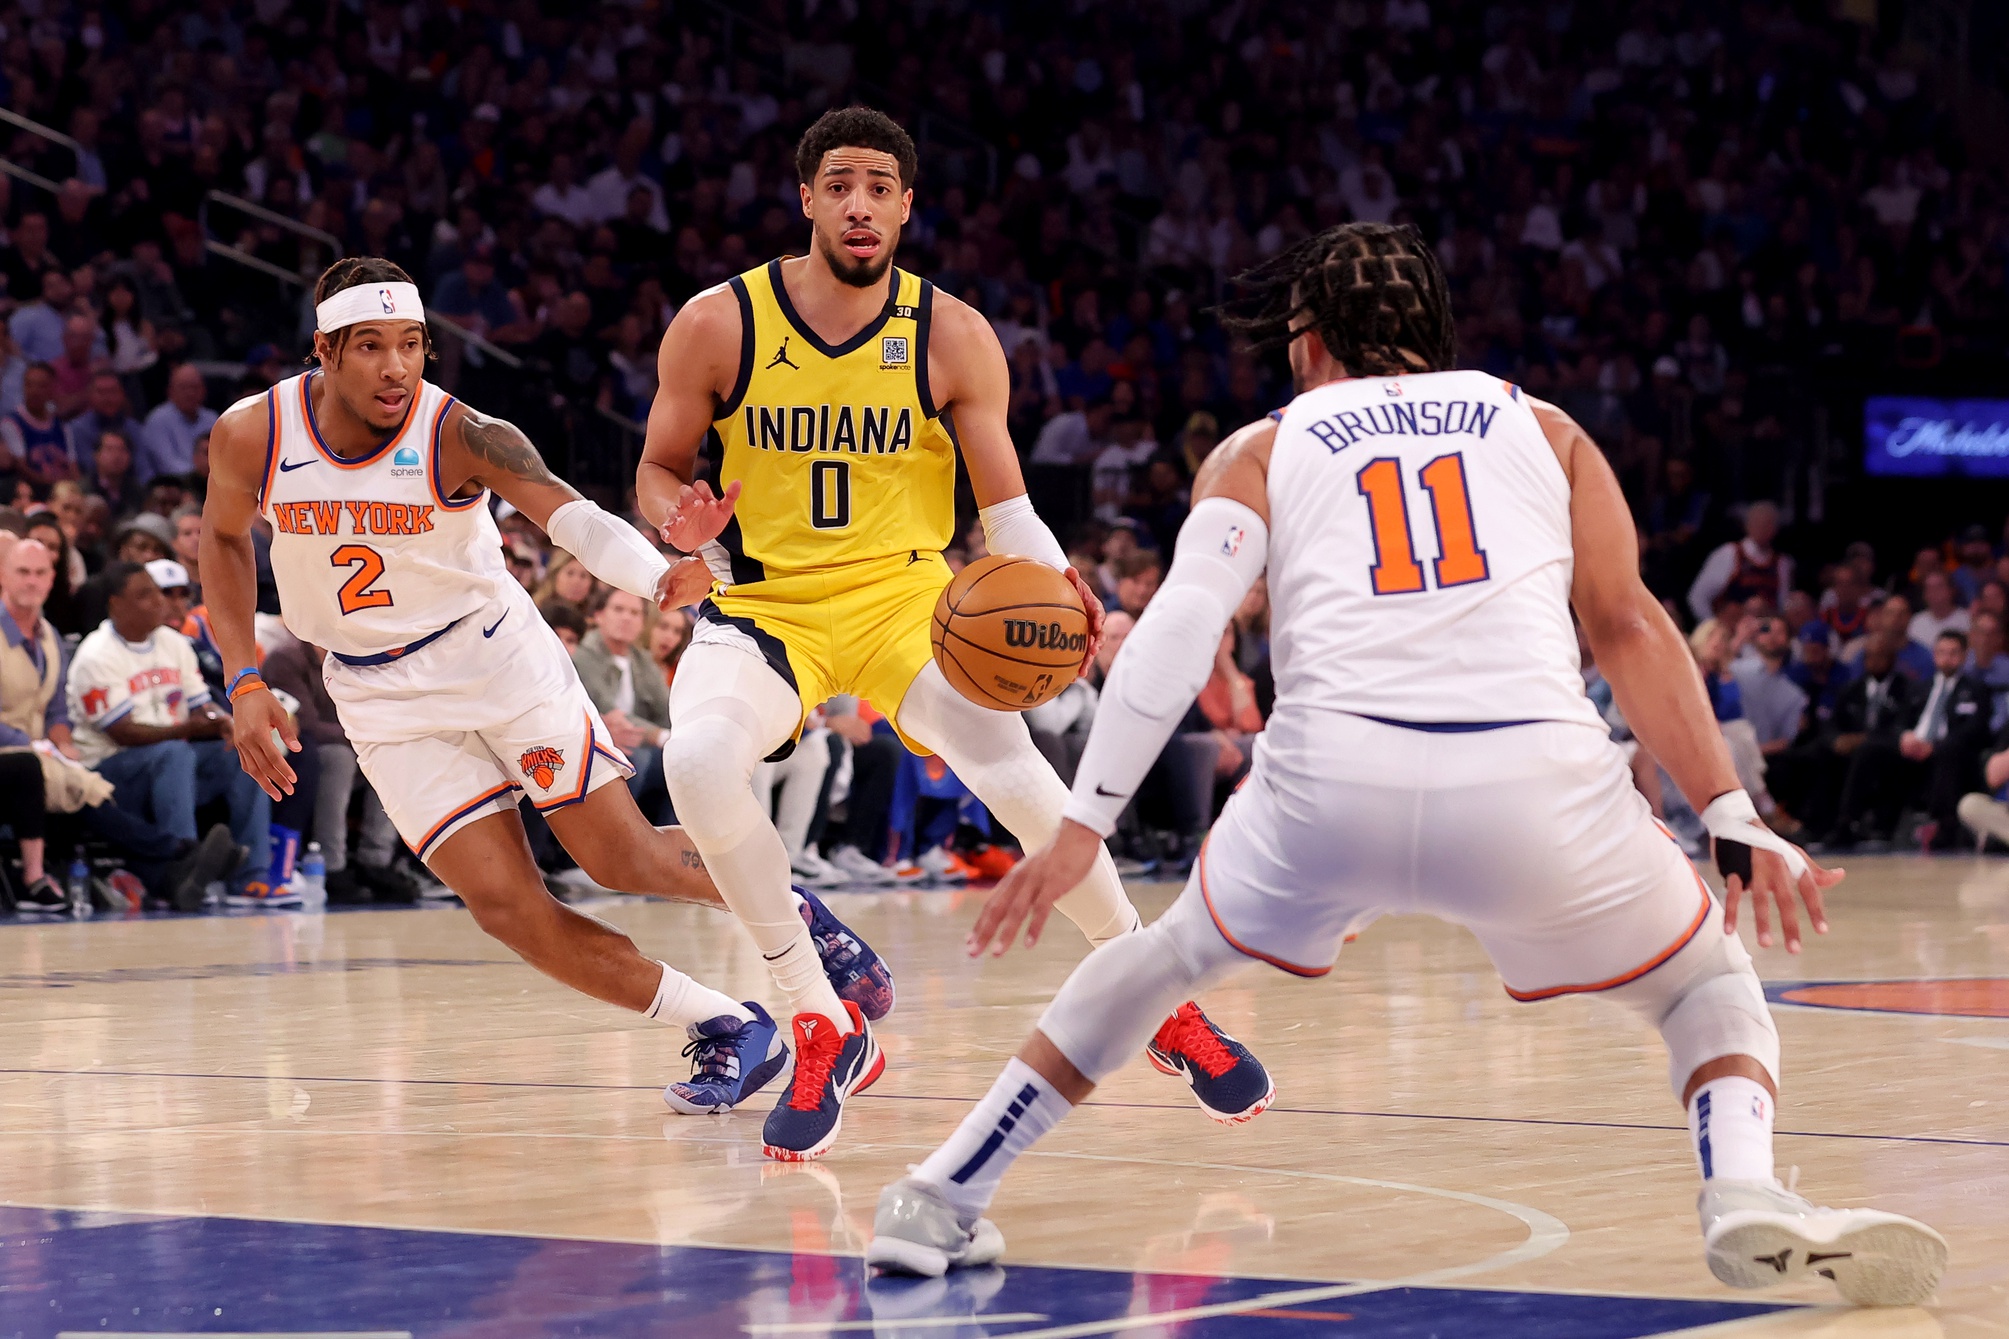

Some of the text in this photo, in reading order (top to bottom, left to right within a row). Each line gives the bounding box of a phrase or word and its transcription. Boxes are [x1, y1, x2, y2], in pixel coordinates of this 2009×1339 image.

[897, 307, 912, 317] 30
[744, 403, 912, 455] INDIANA
[1306, 401, 1501, 454] BRUNSON
[390, 468, 424, 477] sphere
[810, 459, 851, 531] 0
[272, 501, 434, 535] NEW YORK
[1356, 451, 1490, 596] 11
[330, 544, 394, 616] 2
[1003, 618, 1087, 652] Wilson
[521, 747, 565, 773] KNICKS
